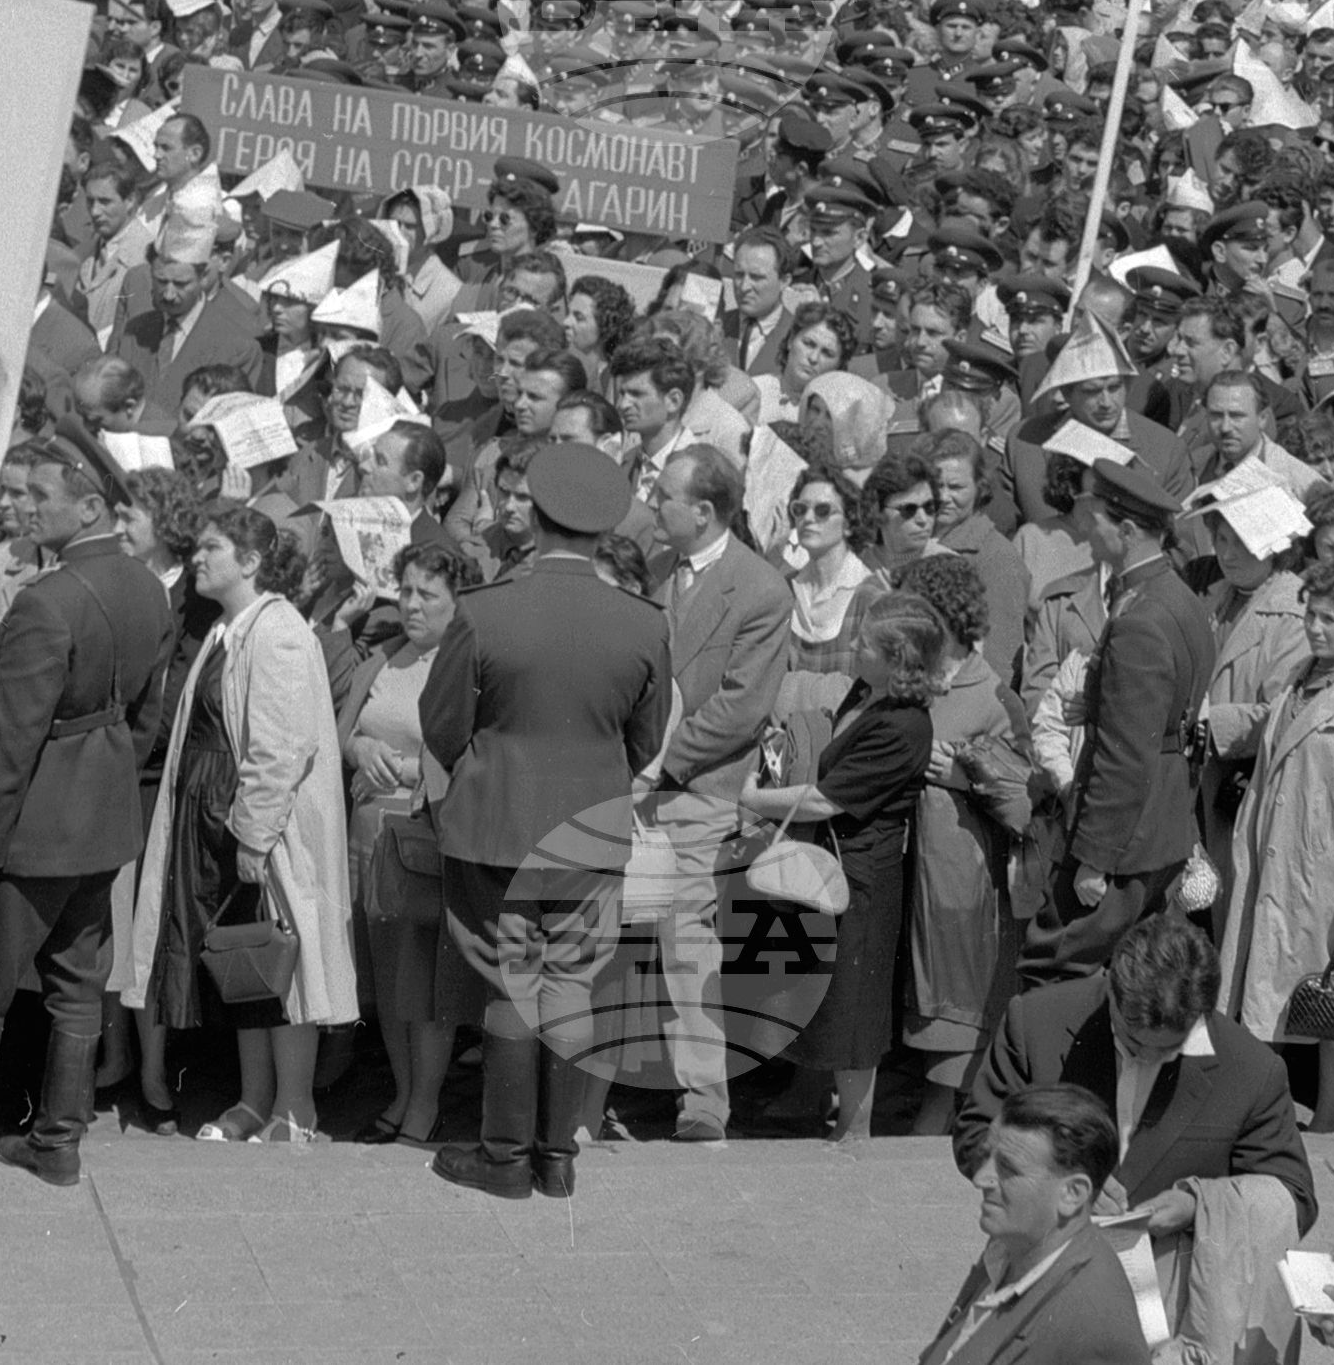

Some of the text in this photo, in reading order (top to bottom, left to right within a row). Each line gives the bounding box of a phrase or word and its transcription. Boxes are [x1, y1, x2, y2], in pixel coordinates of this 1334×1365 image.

[219, 72, 704, 185] СЛАВА НА ПЪРВИЯ КОСМОНАВТ
[333, 145, 373, 187] НА
